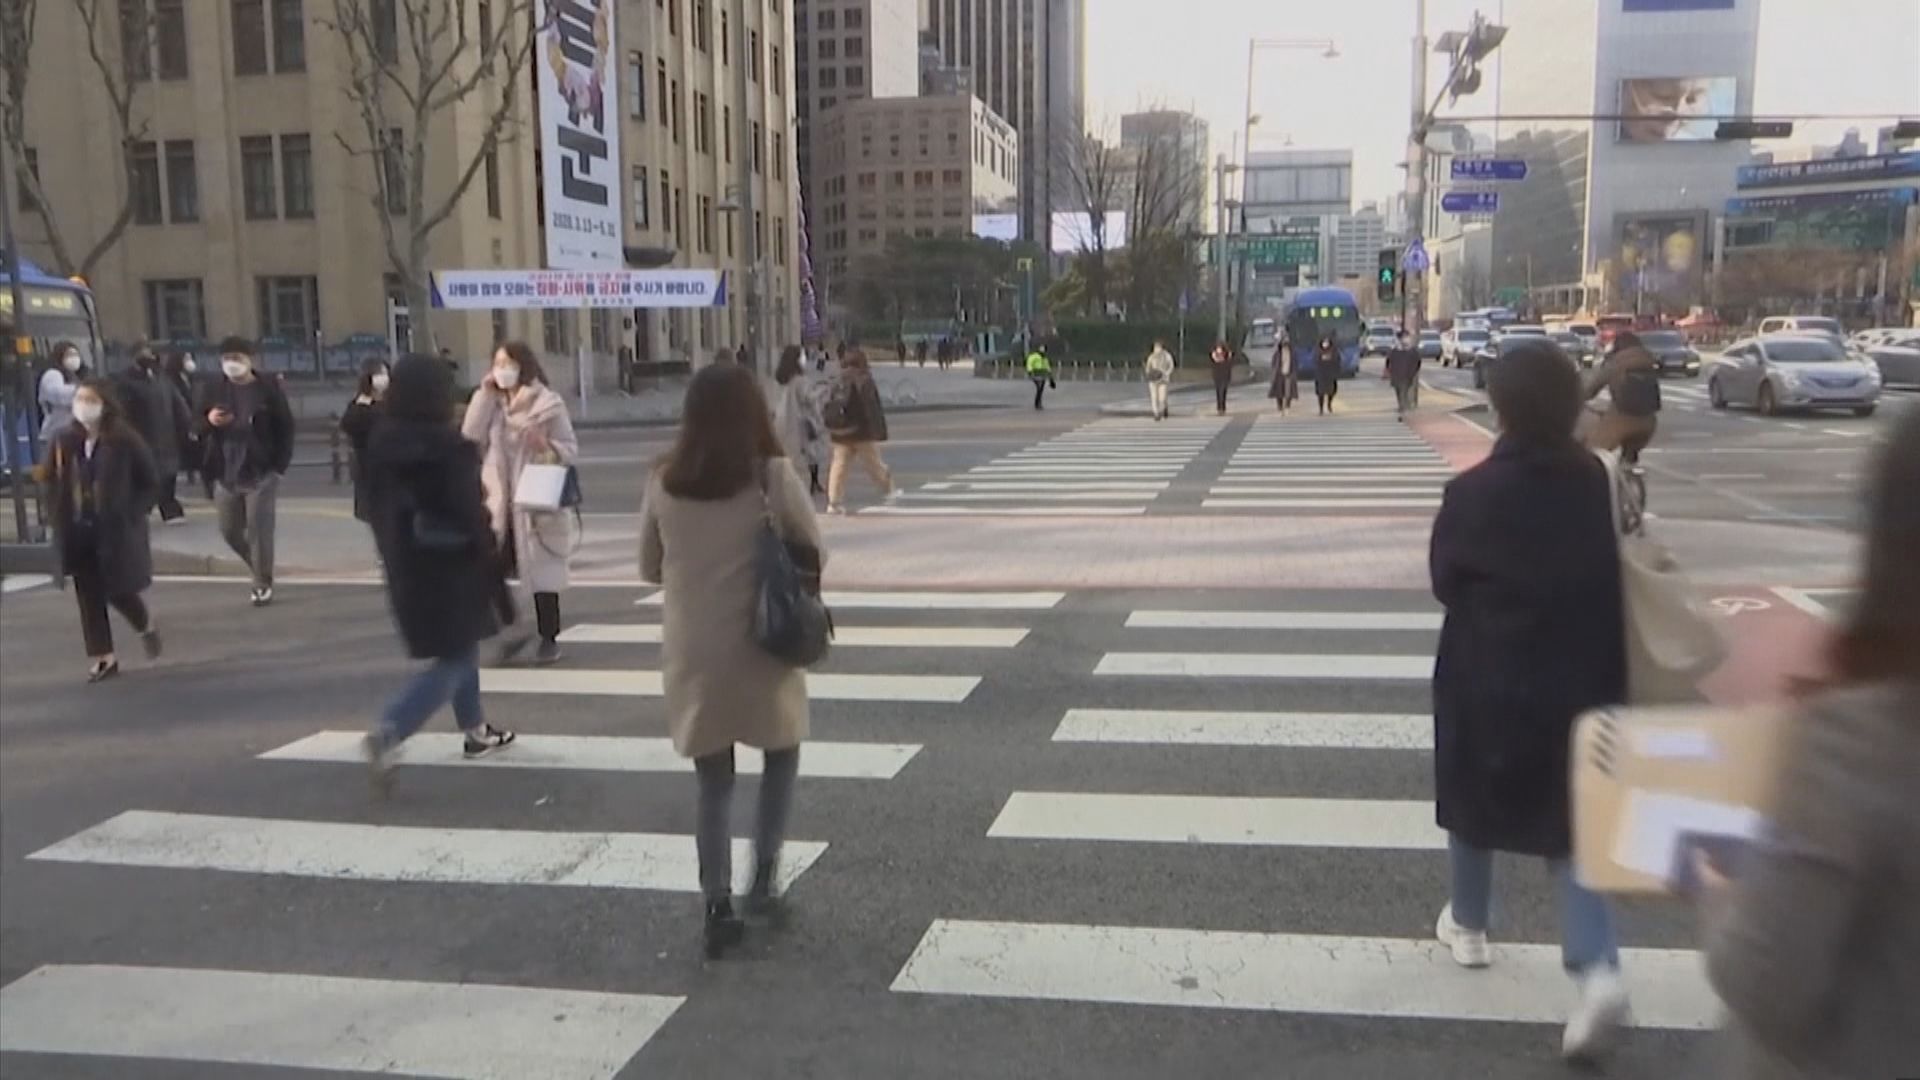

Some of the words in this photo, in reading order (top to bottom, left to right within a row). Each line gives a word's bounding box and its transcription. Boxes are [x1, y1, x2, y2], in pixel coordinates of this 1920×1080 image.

[448, 282, 478, 297] 사람이
[481, 282, 501, 297] 많이
[634, 282, 663, 296] 주시기
